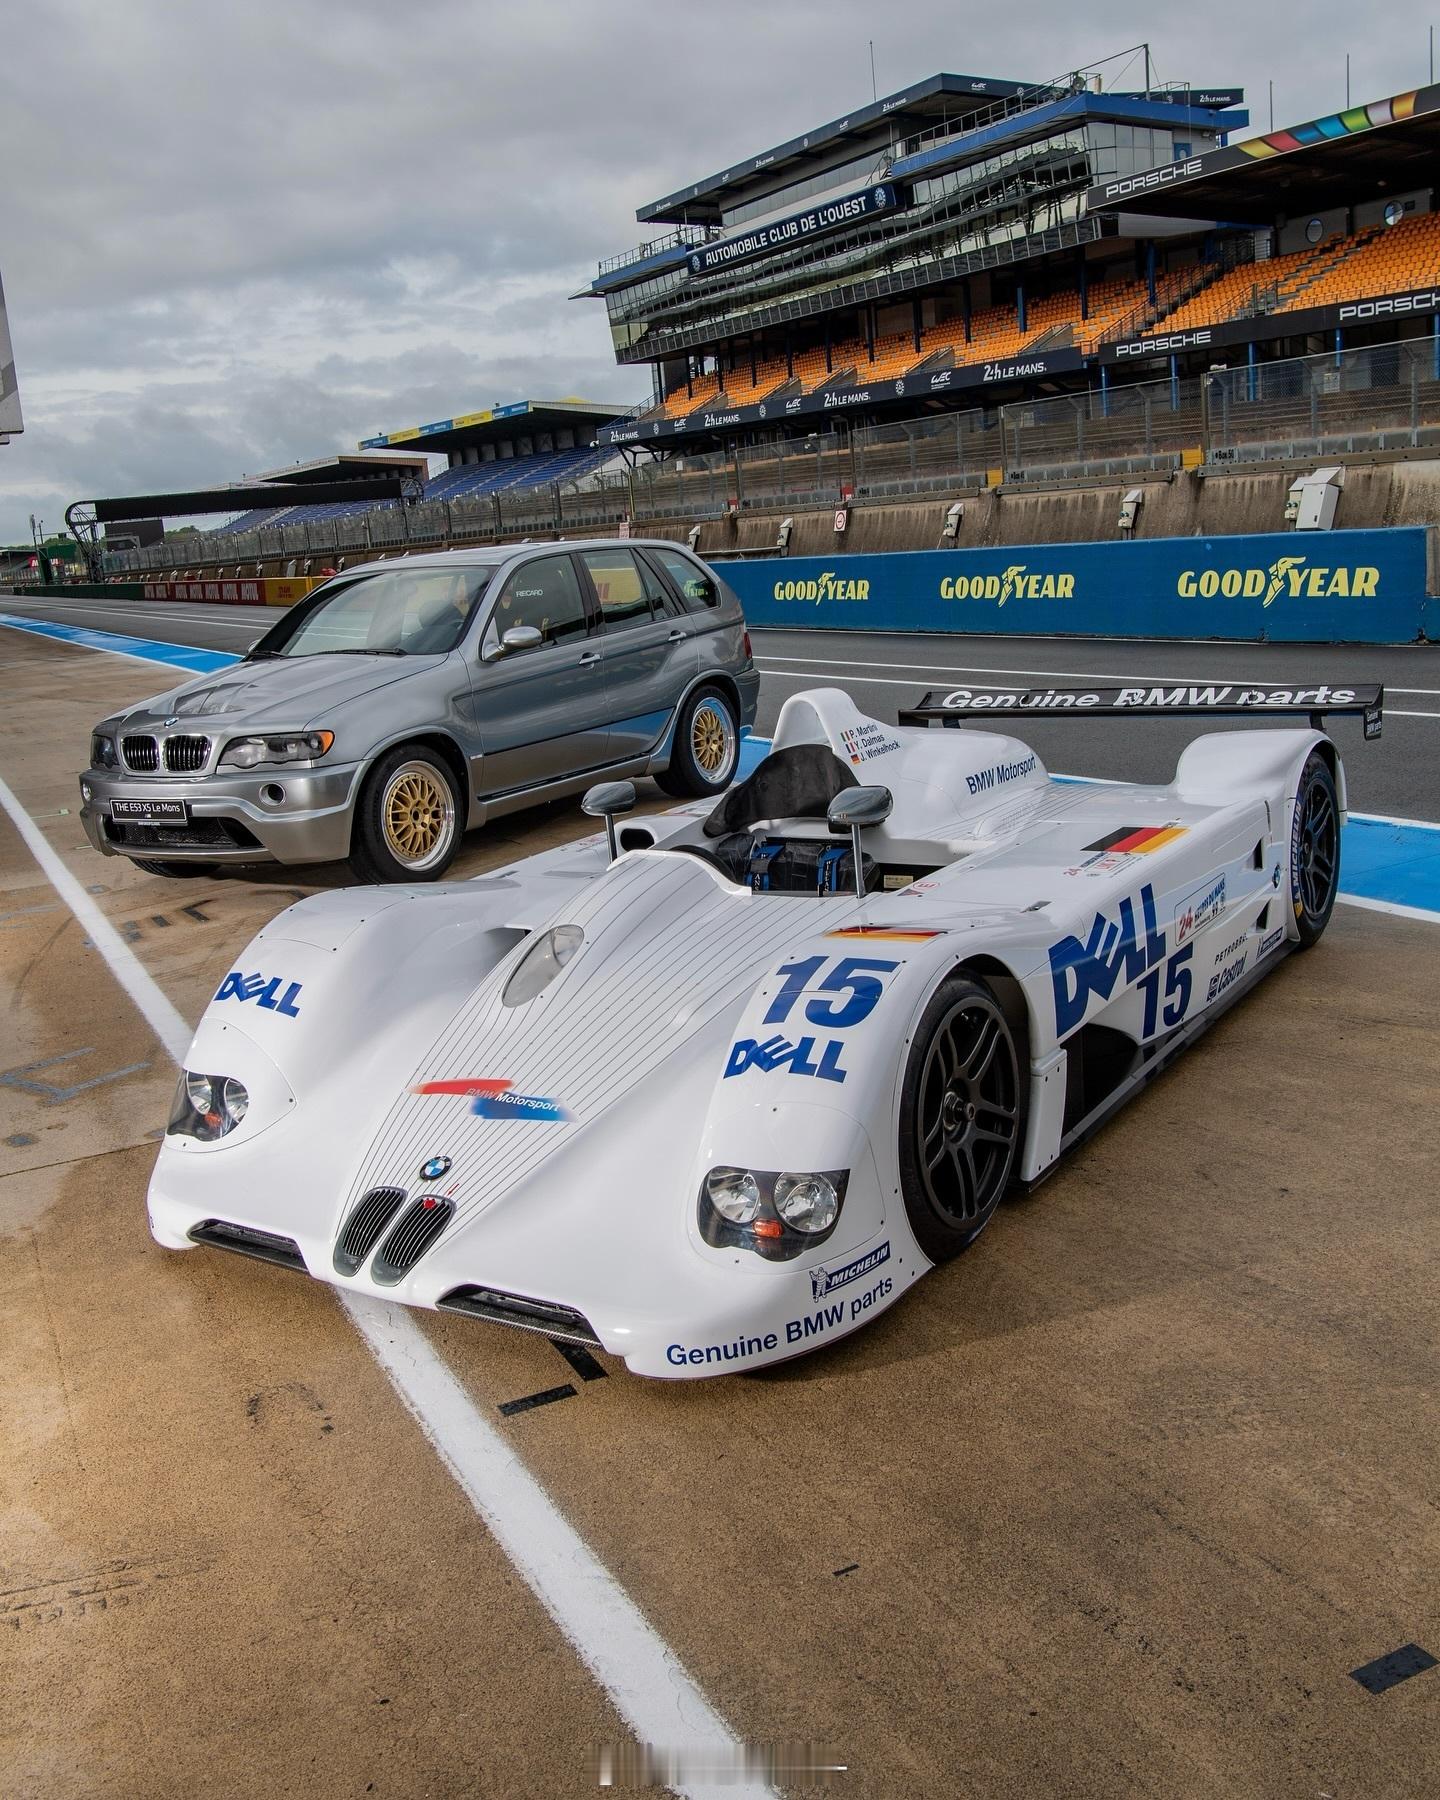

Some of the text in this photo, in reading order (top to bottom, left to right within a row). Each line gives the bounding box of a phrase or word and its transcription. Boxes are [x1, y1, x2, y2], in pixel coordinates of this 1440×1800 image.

[1106, 159, 1202, 198] PORSCHE
[706, 196, 867, 266] AUTOMOBILE CLUB DE L'OUEST
[1116, 331, 1211, 357] PORSCHE
[1002, 367, 1014, 378] LE
[1015, 362, 1045, 376] MANS
[838, 395, 847, 405] LE
[847, 392, 869, 402] MANS
[715, 417, 723, 425] LE
[723, 414, 740, 424] MANS
[942, 686, 1356, 708] Genuine BMW parts
[849, 729, 858, 739] P.
[853, 734, 885, 750] Y. Dalmas
[965, 753, 1036, 795] BMW Motorsport
[114, 802, 129, 812] THE
[152, 803, 161, 812] Le
[1292, 801, 1303, 887] MICHELIN
[1179, 907, 1193, 941] 24
[1048, 883, 1166, 1039] DELL
[213, 973, 303, 1018] DELL
[762, 956, 900, 1028] 15
[1137, 942, 1193, 1040] 15
[723, 1034, 847, 1083] DELL
[465, 1088, 559, 1112] BMW Motorsport
[831, 1246, 889, 1286] MICHELIN
[667, 1277, 893, 1366] Genuine BMW parts
